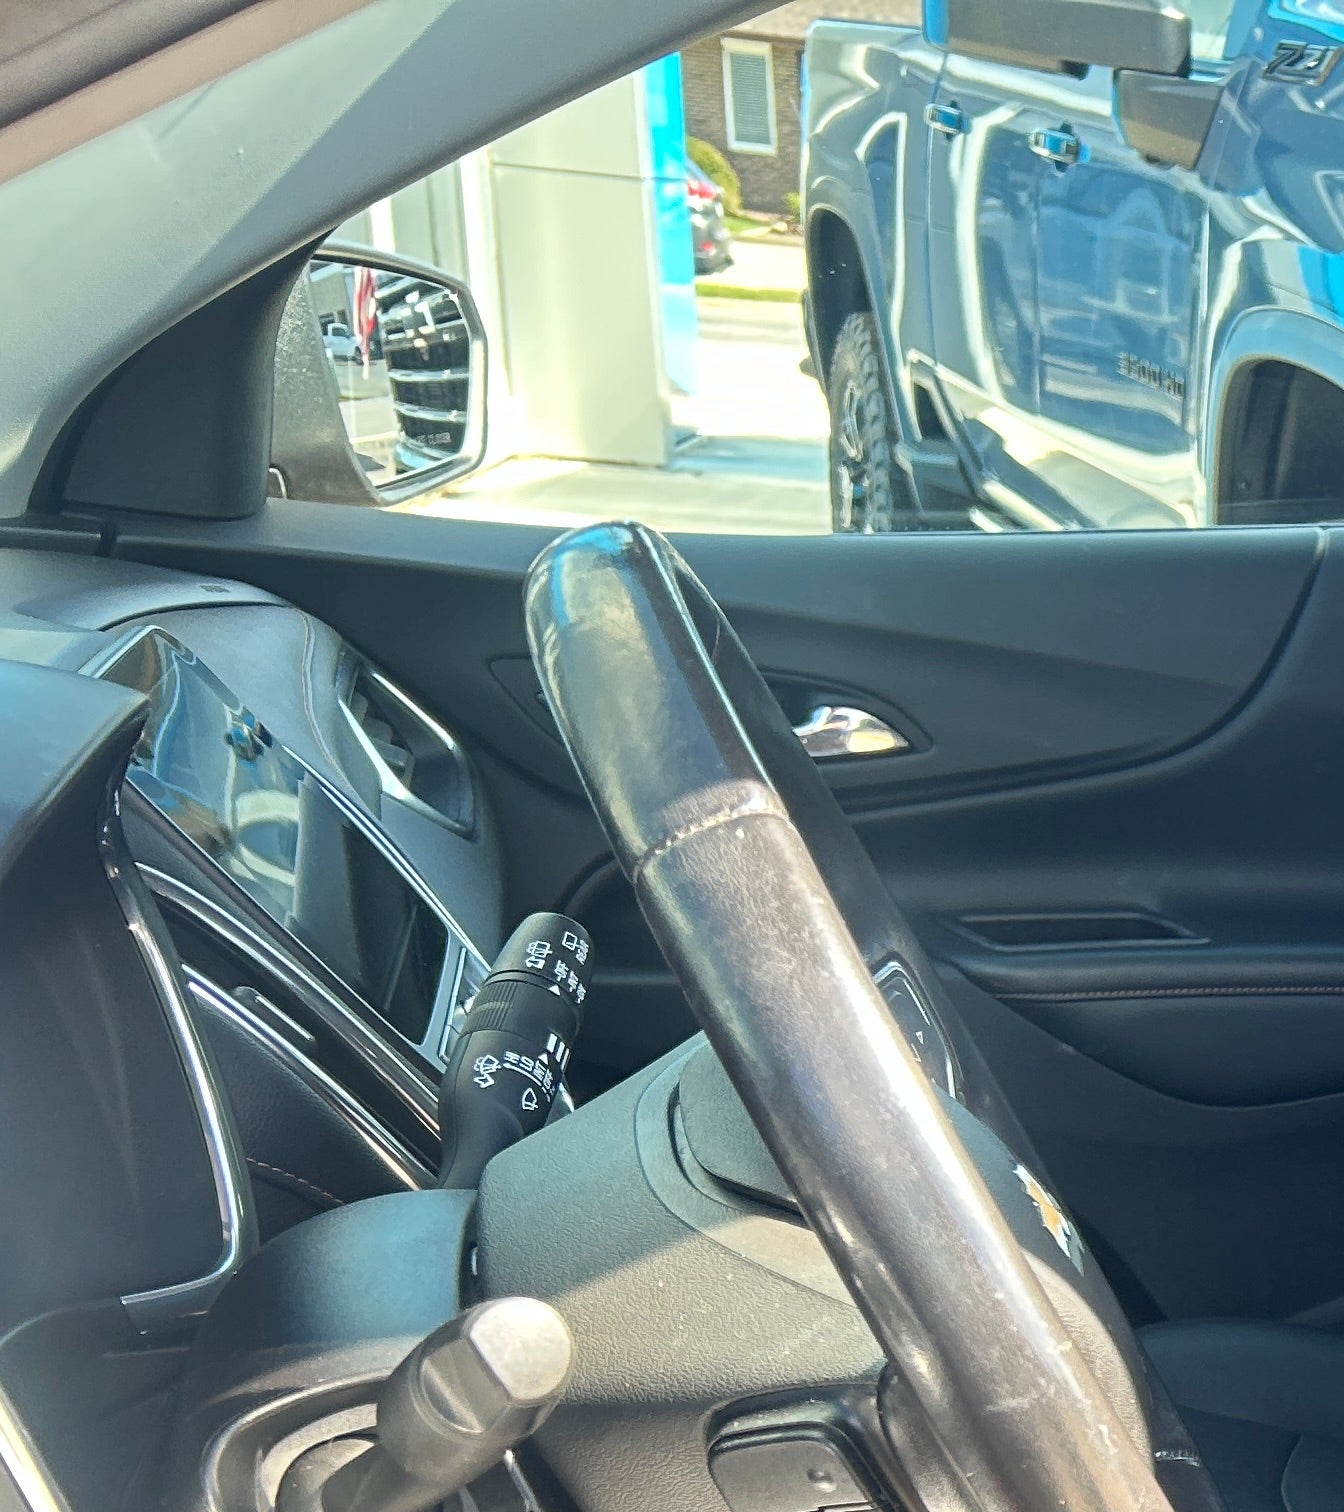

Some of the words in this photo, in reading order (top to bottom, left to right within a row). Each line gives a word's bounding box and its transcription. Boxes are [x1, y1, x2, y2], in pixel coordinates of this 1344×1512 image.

[503, 1050, 520, 1064] HI
[520, 1056, 535, 1071] LO
[533, 1059, 547, 1081] INT
